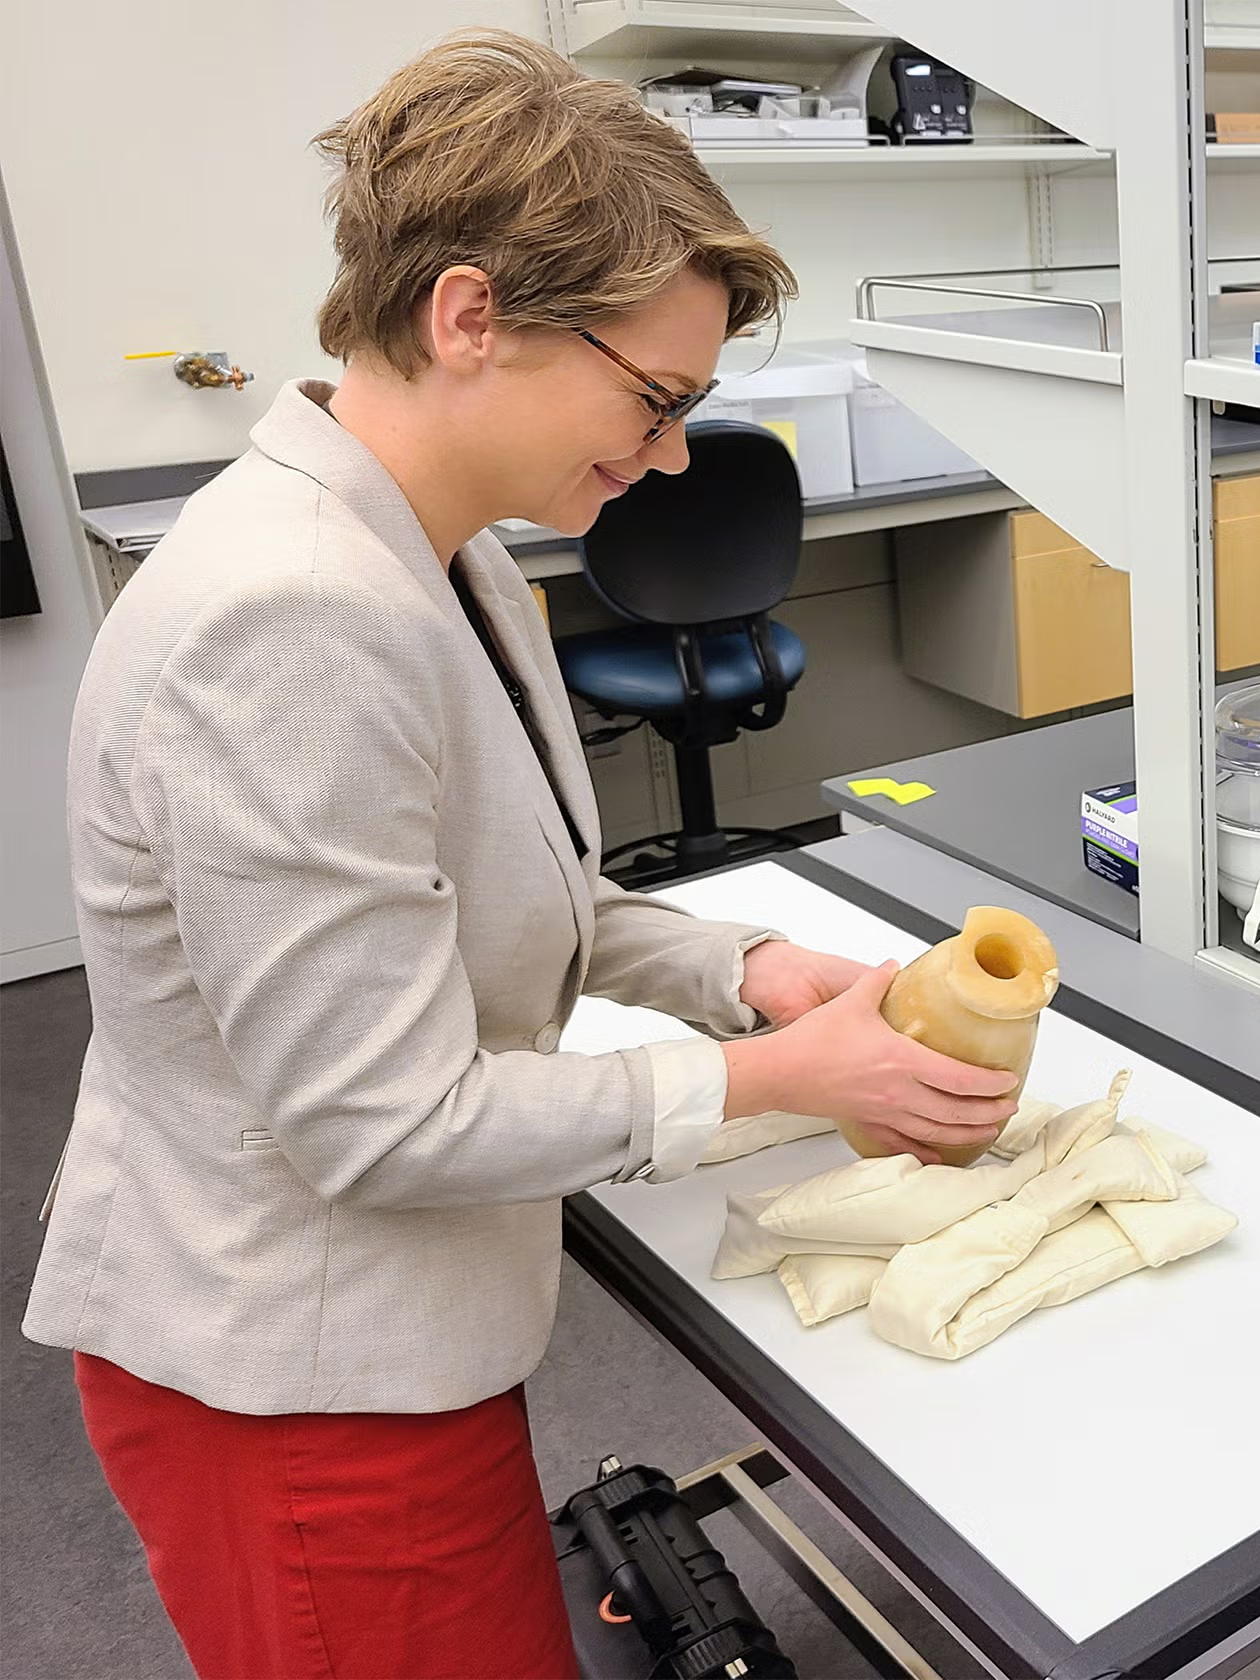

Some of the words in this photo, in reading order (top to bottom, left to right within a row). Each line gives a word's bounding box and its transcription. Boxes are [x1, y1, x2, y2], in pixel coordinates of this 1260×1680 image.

[1092, 807, 1116, 824] HALYARD
[1086, 819, 1107, 837] PURPLE
[1106, 829, 1129, 849] NITRILE
